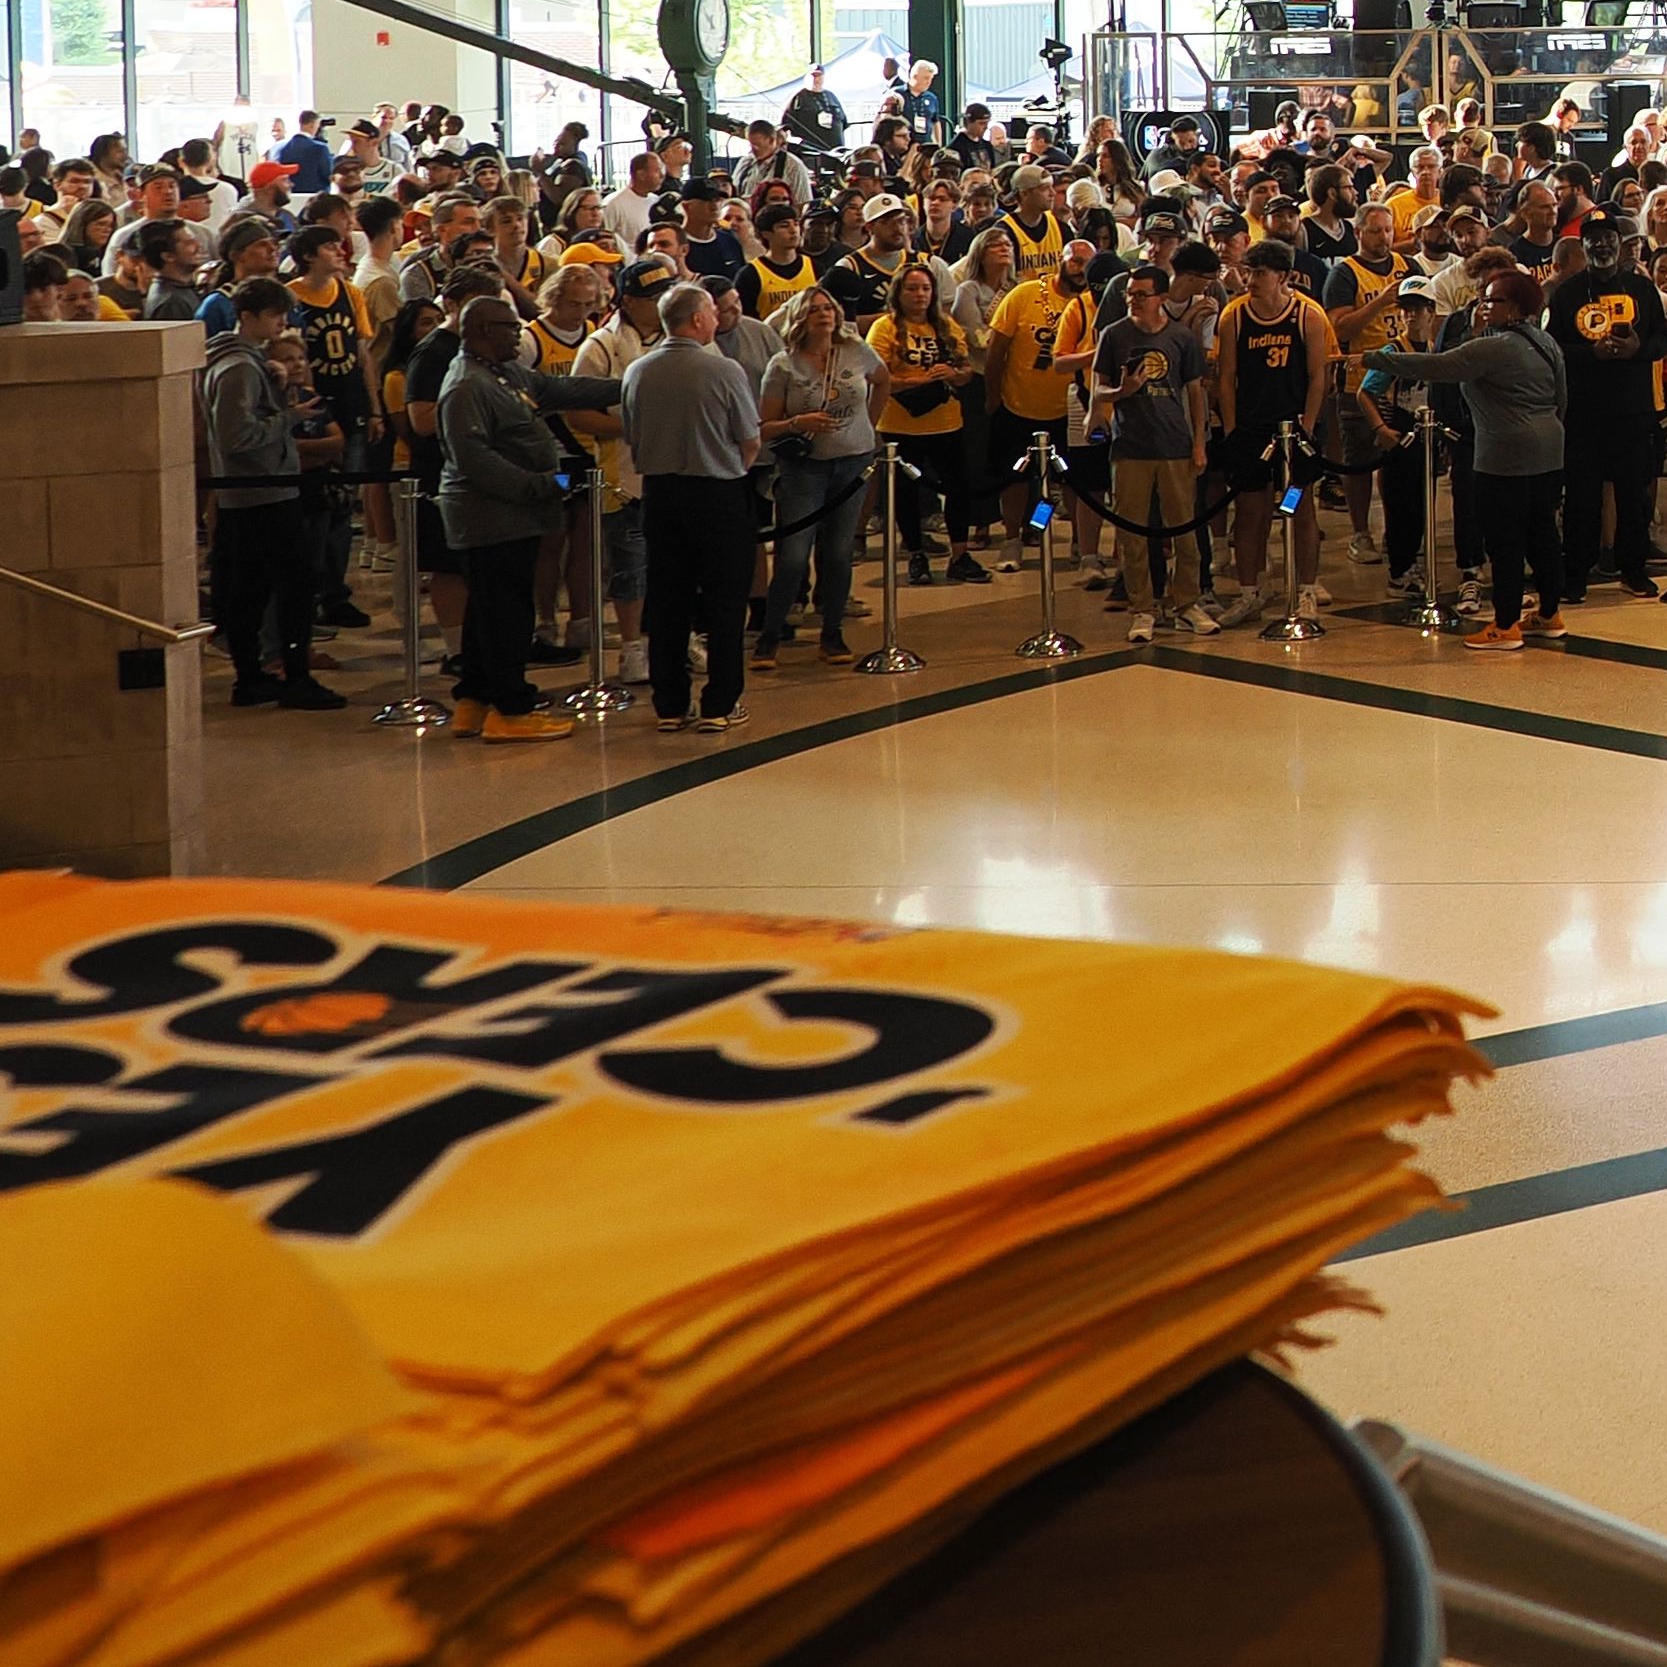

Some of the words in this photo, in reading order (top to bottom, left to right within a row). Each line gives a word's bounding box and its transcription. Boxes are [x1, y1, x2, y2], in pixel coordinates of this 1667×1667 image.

[325, 329, 345, 359] 0
[1248, 333, 1292, 349] Indiana
[1266, 346, 1289, 368] 31
